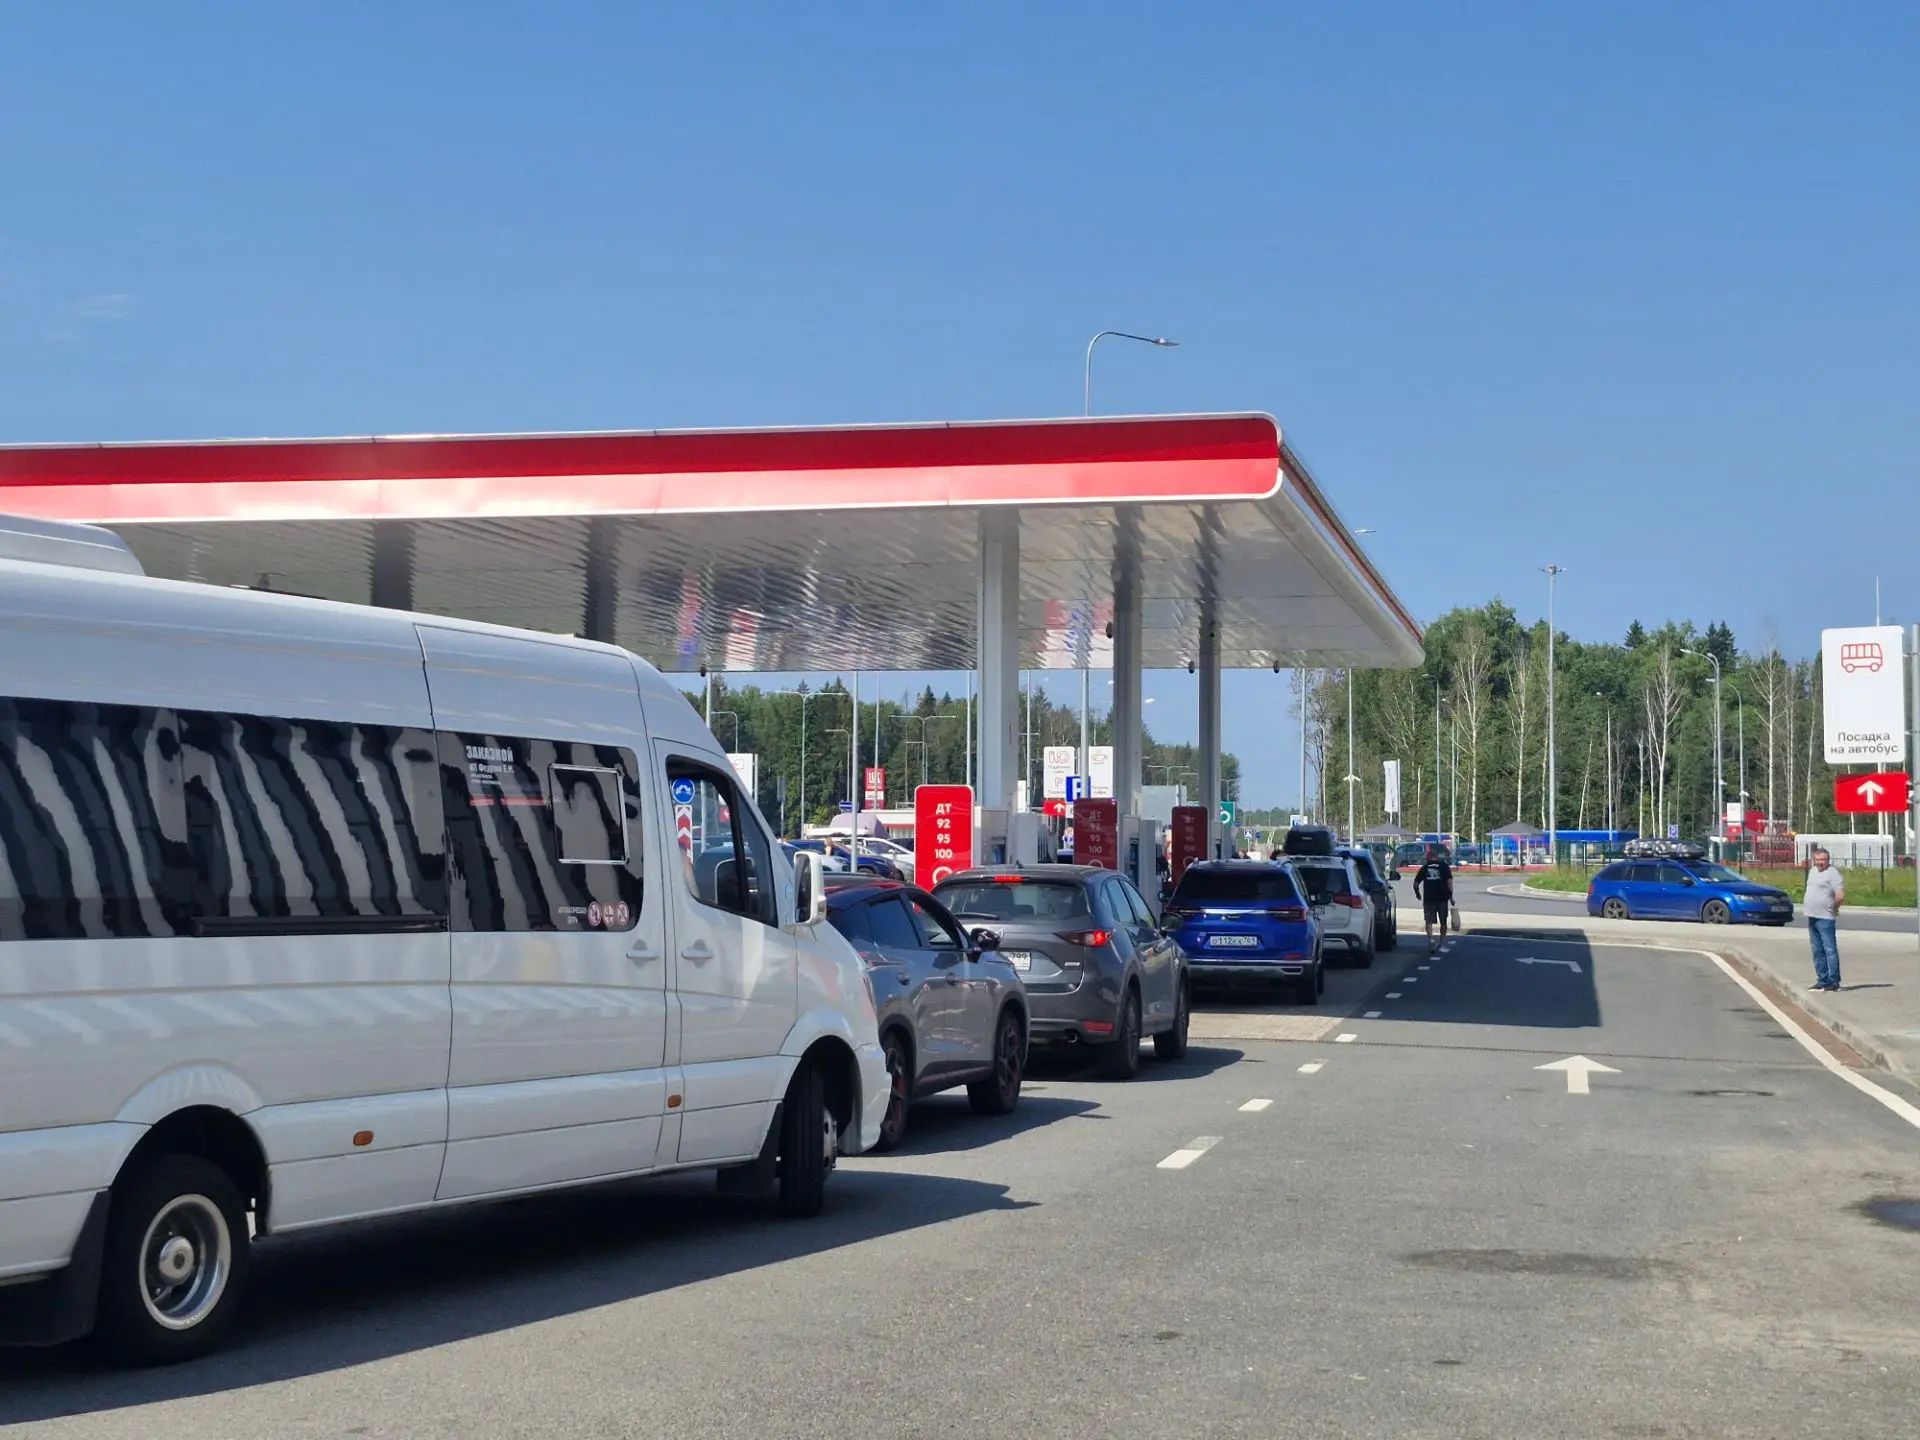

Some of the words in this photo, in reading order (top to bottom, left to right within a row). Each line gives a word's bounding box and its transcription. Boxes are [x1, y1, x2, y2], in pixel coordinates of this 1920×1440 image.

[1837, 732, 1890, 742] Посадка
[465, 745, 514, 762] ЗАКАЗНОЙ
[1830, 746, 1844, 754] на
[1848, 743, 1898, 755] автобус
[936, 803, 952, 815] ДТ
[937, 819, 951, 829] 92
[937, 834, 951, 844] 95
[1090, 834, 1100, 842] 95
[934, 849, 953, 859] 100
[1089, 845, 1103, 854] 100
